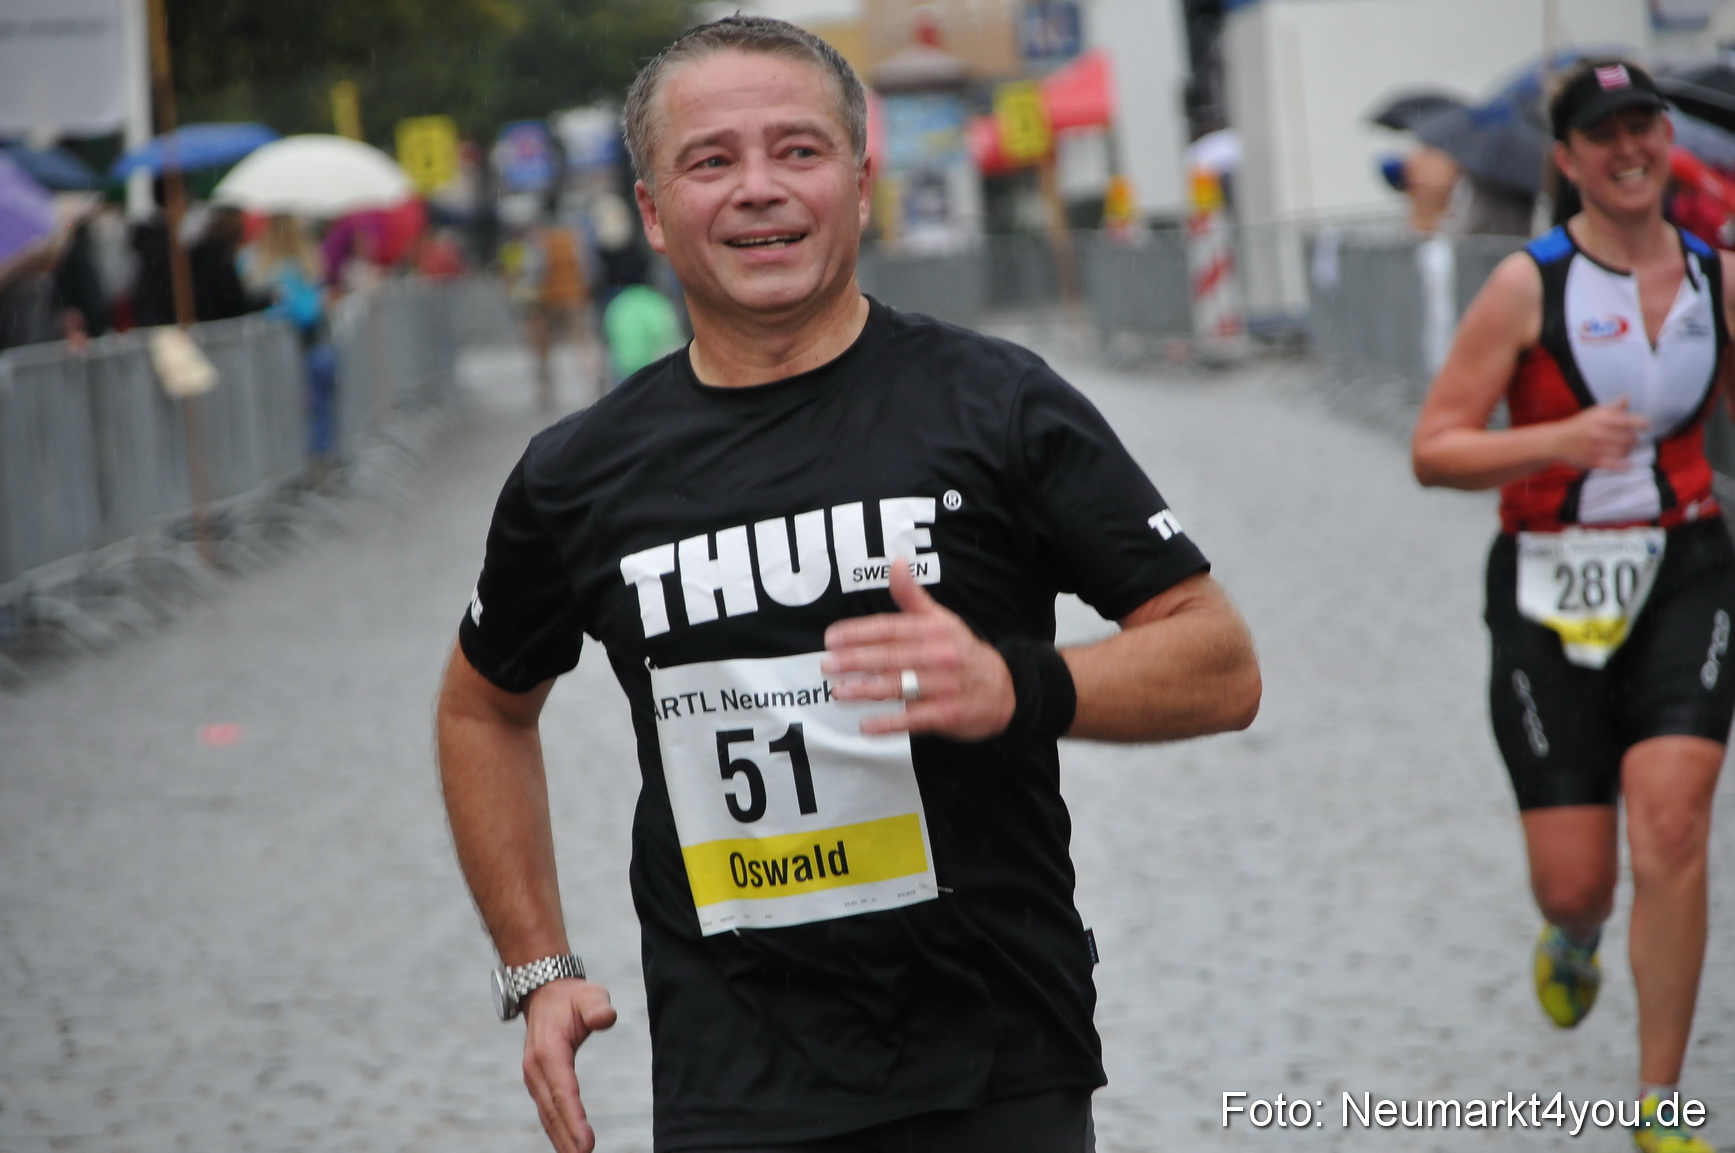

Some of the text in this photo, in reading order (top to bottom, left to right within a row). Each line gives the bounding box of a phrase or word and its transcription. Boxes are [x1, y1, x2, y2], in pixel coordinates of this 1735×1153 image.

[620, 497, 941, 638] THULE
[853, 562, 928, 583] SWEEN
[1555, 561, 1638, 611] 280
[719, 679, 837, 711] Neumark
[716, 722, 818, 824] 51
[729, 840, 850, 889] Oswald
